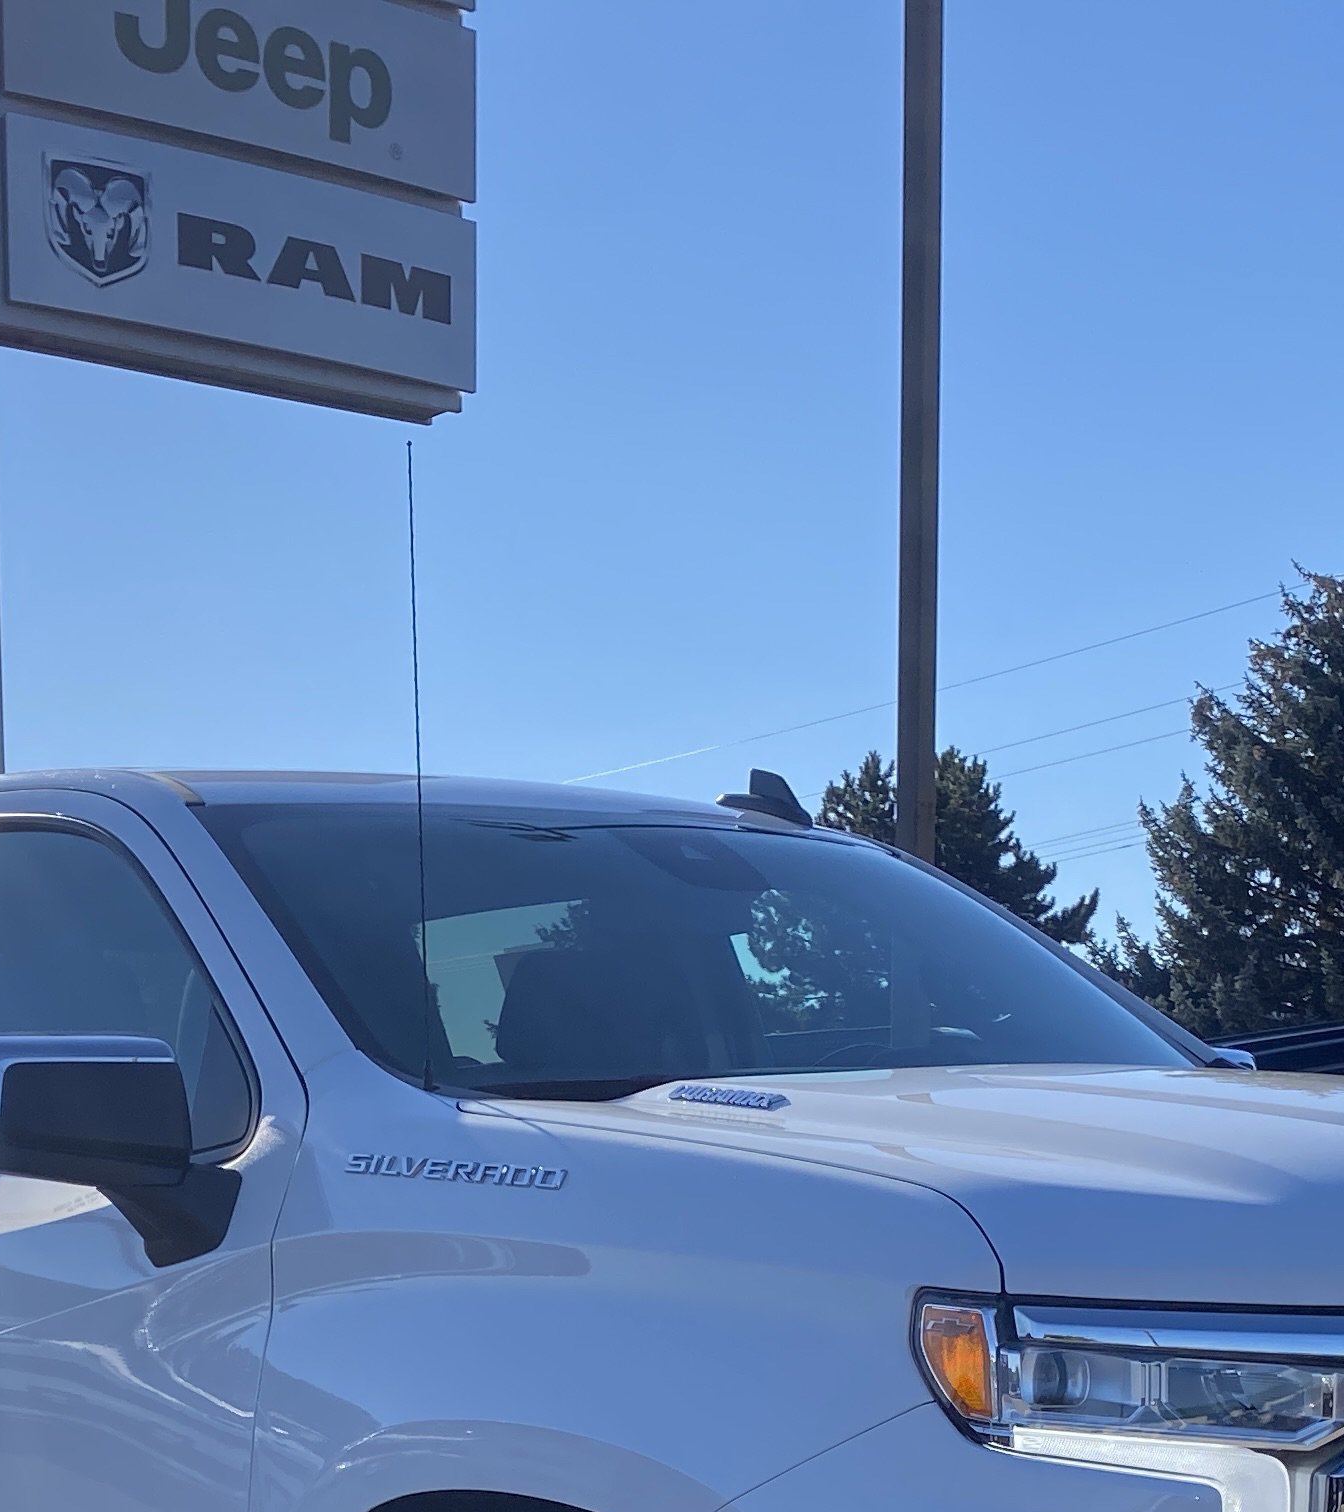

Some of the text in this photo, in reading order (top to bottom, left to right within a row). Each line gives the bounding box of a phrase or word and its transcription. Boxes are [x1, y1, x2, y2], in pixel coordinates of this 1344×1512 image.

[114, 0, 392, 144] Jeep
[177, 212, 451, 325] RAM
[344, 1153, 569, 1190] SILVERADO
